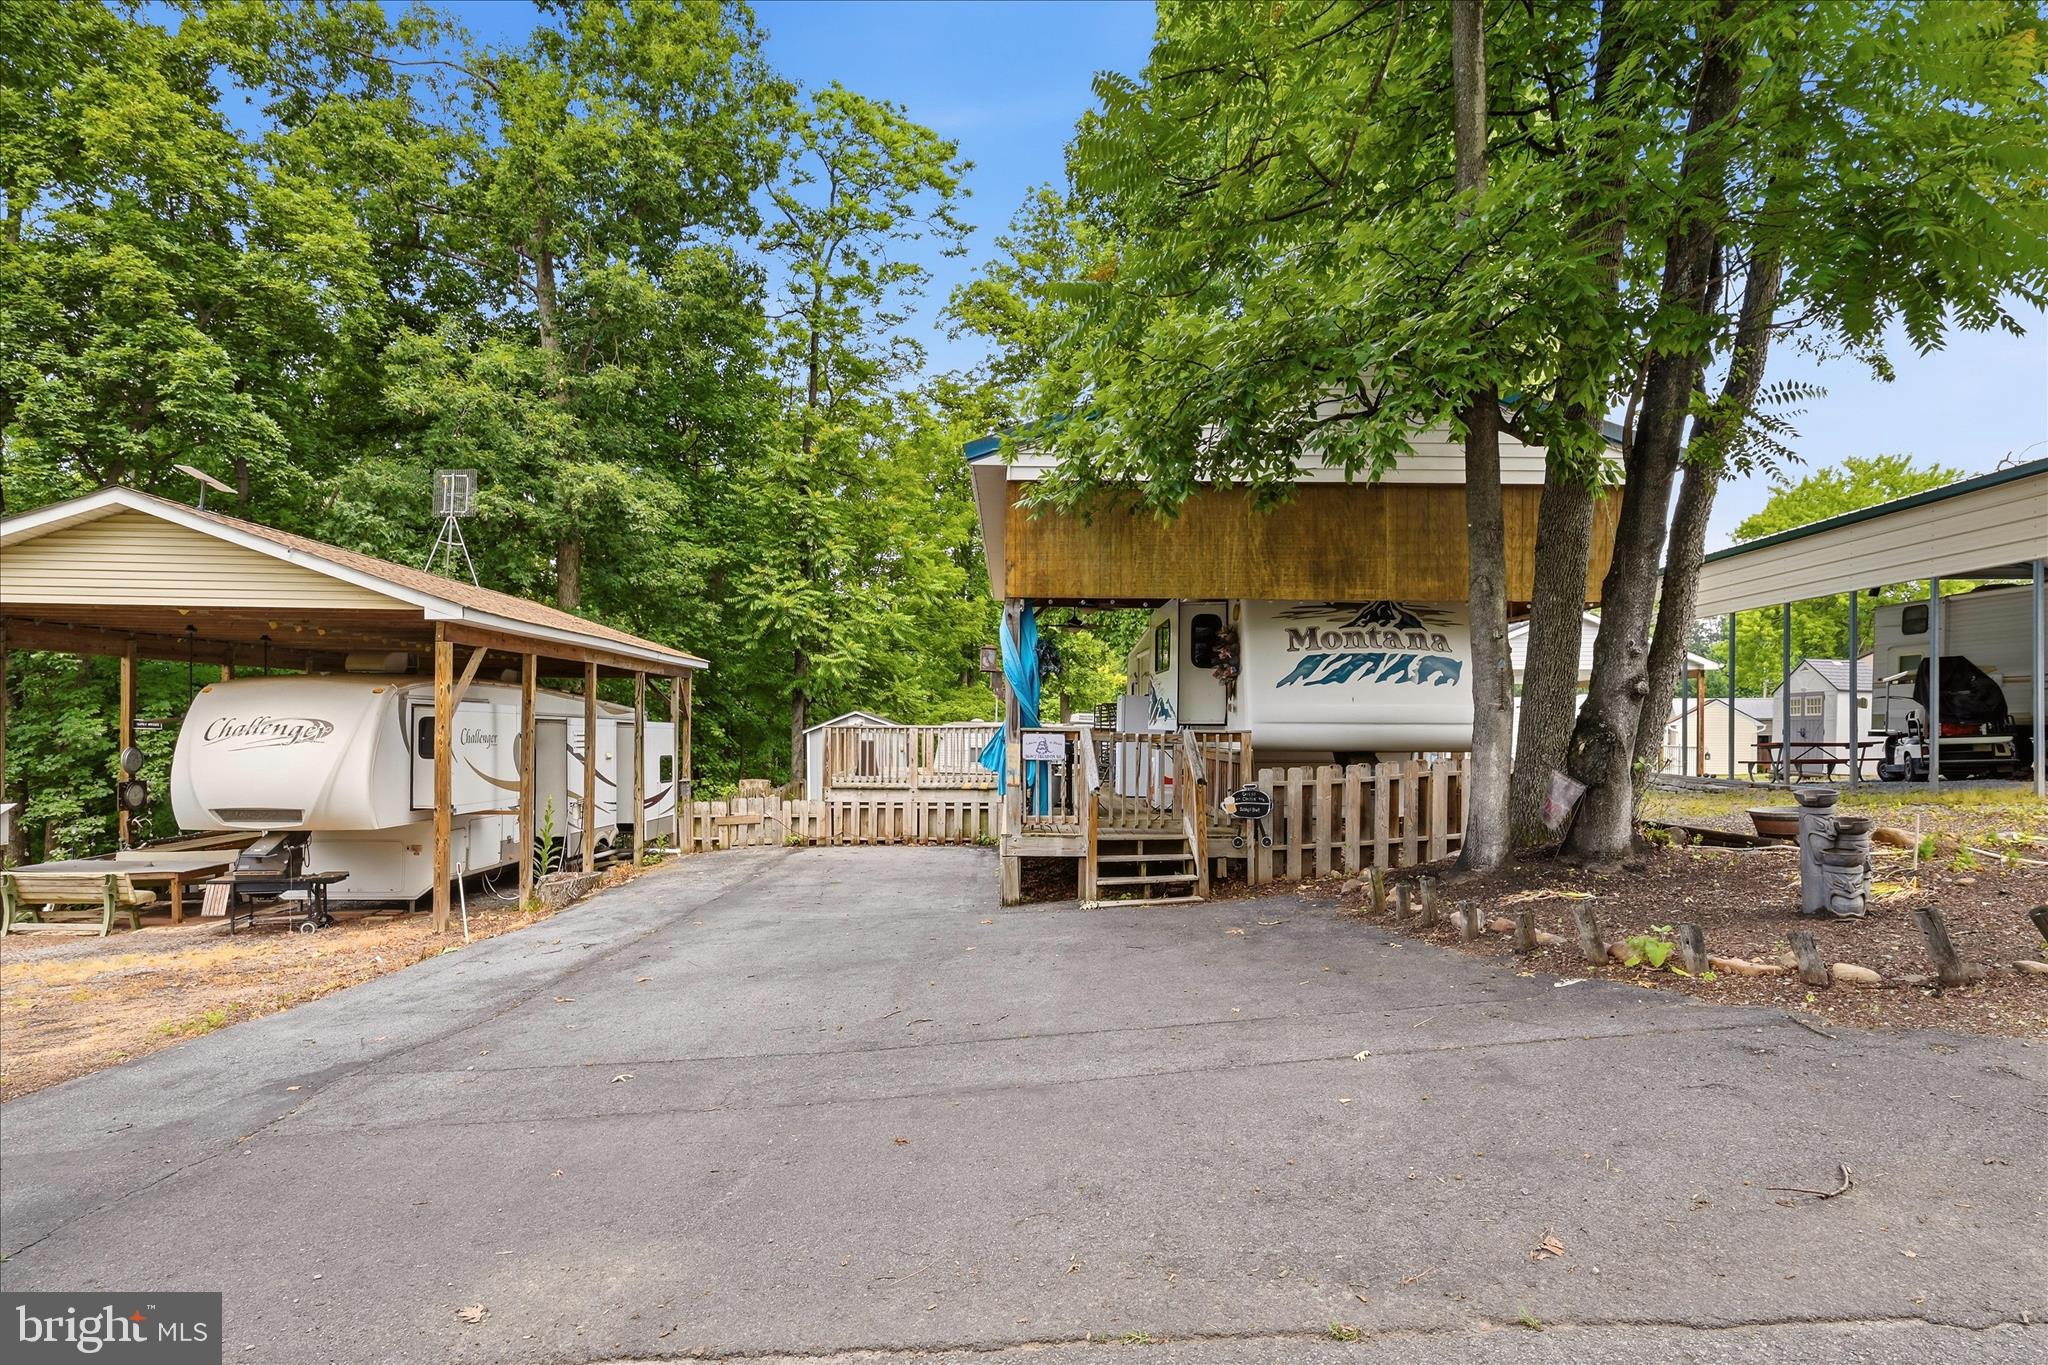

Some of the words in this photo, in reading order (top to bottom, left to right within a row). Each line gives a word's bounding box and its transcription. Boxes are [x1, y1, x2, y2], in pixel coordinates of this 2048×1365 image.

[1285, 626, 1453, 653] Montana
[203, 716, 332, 746] Challenger
[460, 727, 498, 749] Challenger
